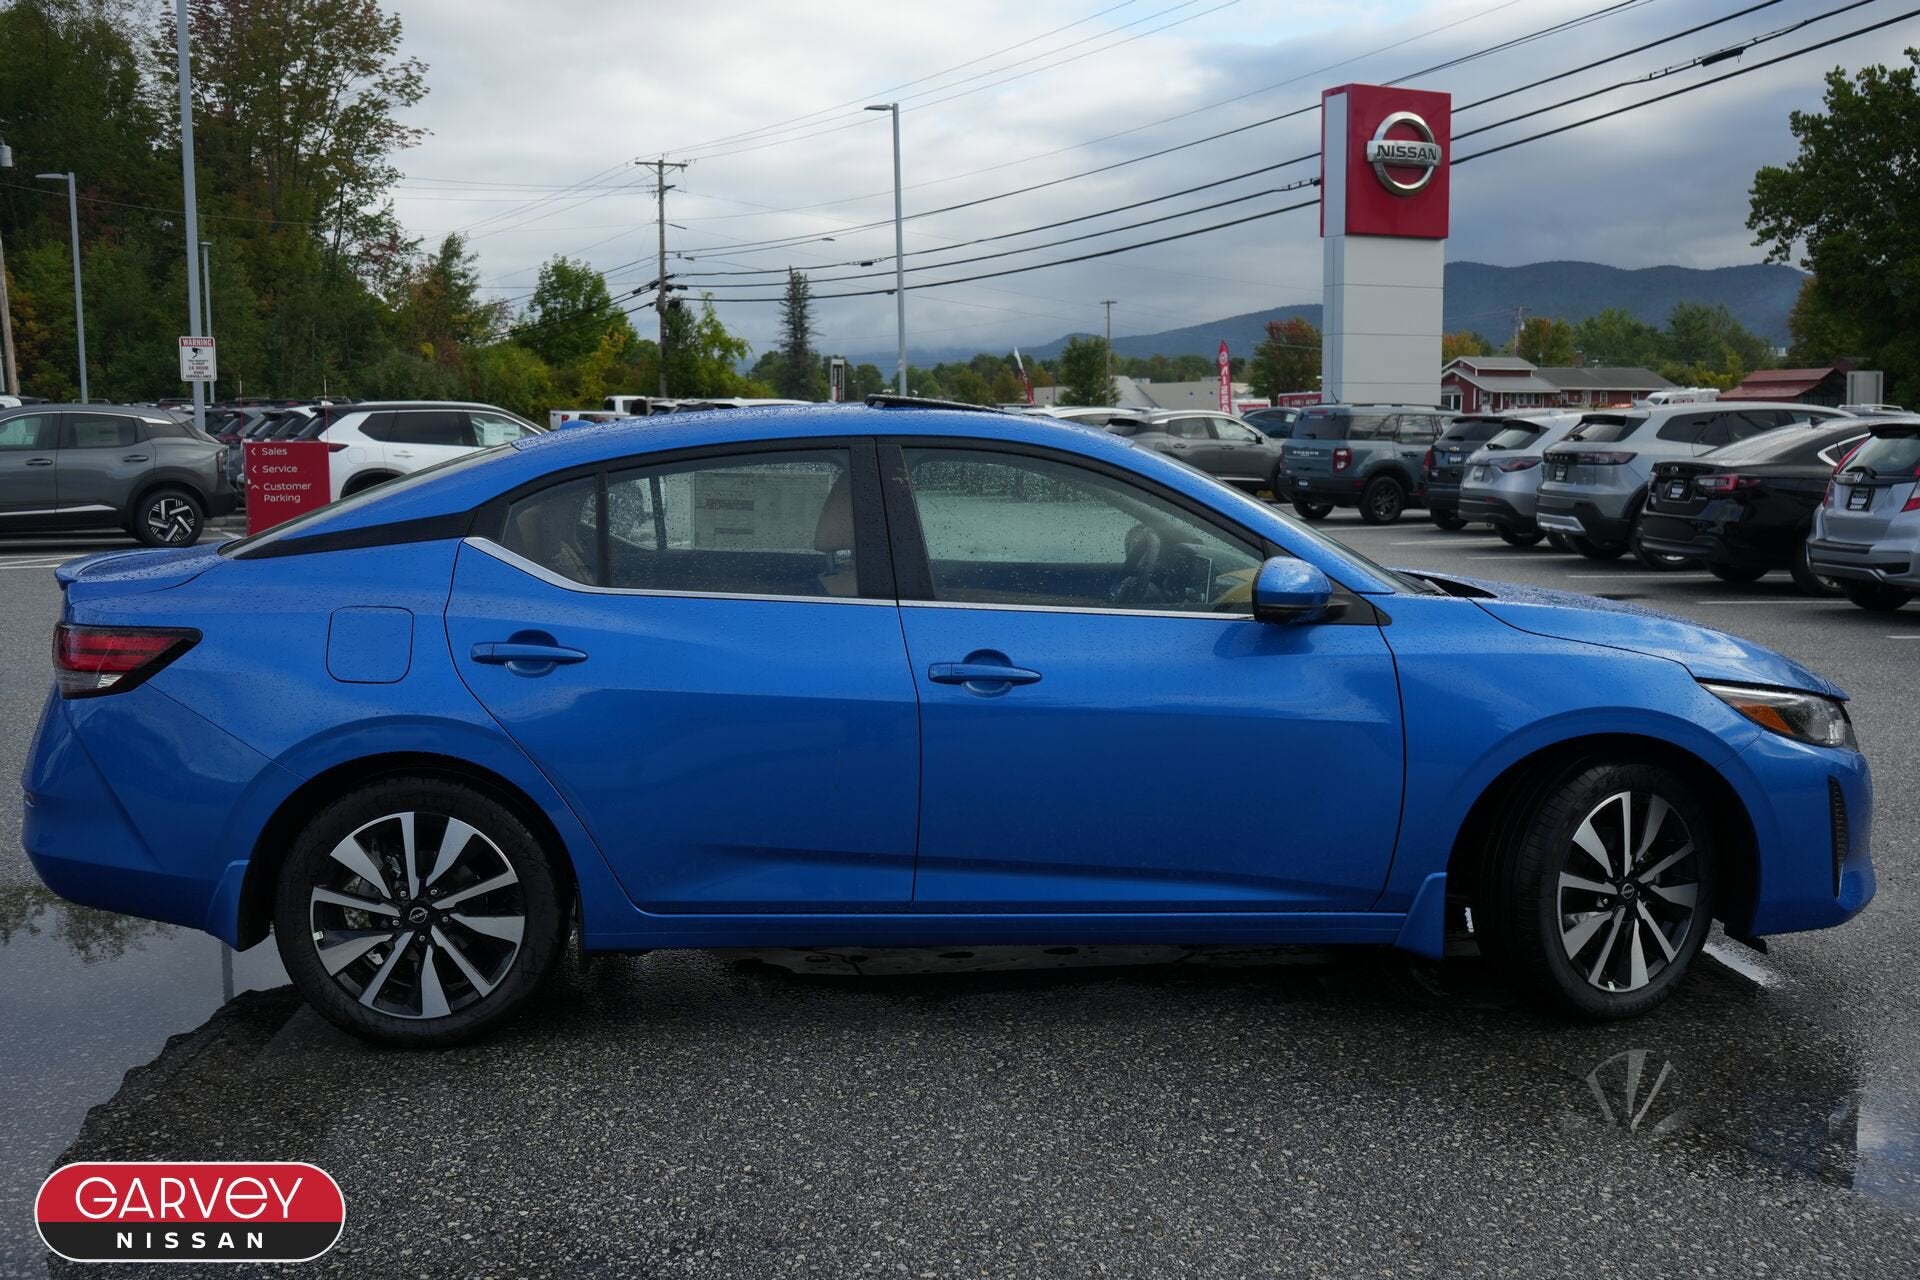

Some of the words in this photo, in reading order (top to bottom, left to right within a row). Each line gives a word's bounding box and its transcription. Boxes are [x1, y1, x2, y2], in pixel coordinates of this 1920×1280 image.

[1376, 144, 1437, 161] NISSAN
[182, 338, 212, 346] WARNING
[261, 447, 288, 456] Sales
[262, 465, 298, 473] Service
[263, 482, 312, 491] Customer
[264, 494, 301, 503] Parking
